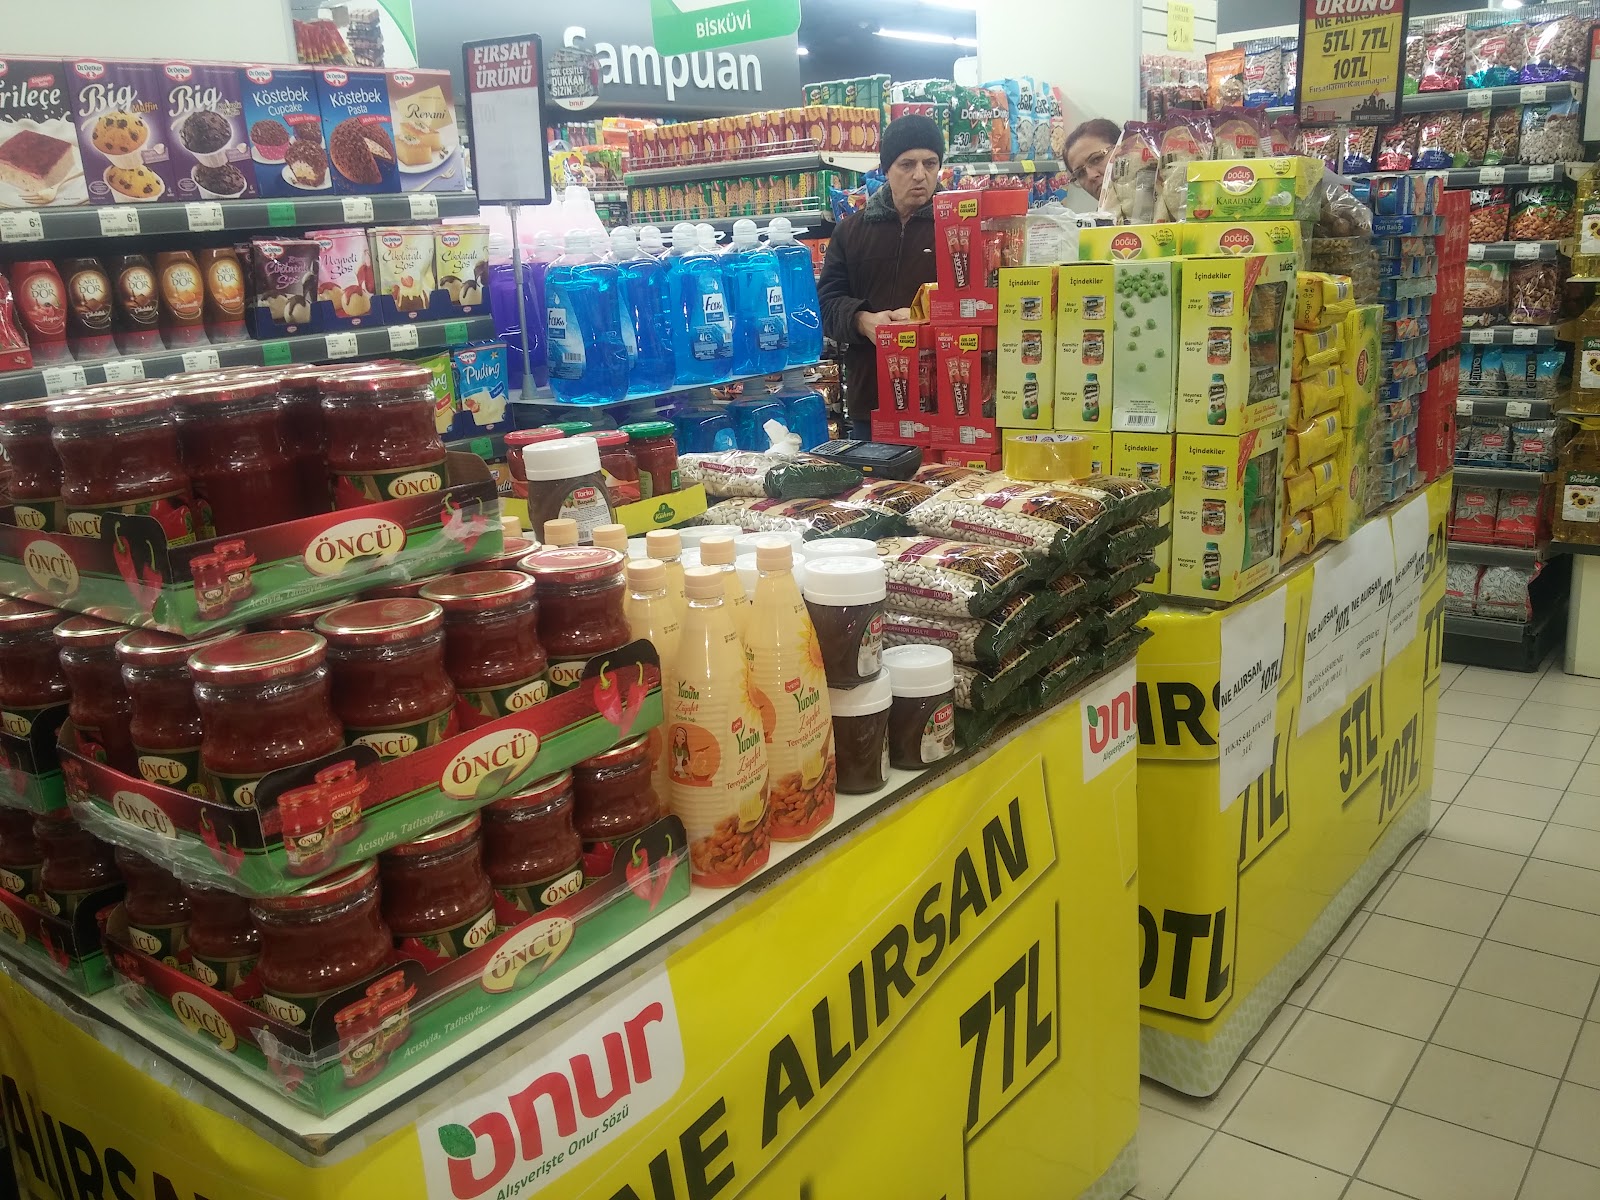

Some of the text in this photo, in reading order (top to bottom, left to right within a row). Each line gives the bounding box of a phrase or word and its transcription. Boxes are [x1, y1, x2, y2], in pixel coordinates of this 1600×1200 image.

[696, 9, 752, 39] BİSKÜVİ
[1323, 27, 1388, 53] 5TL 7TL
[473, 40, 531, 65] FIRSAT
[475, 60, 532, 89] ÜRÜNÜ
[1333, 56, 1368, 80] 10TL
[552, 74, 585, 87] DÜKKAN
[552, 85, 572, 97] SİZİN
[79, 83, 138, 117] Big
[132, 102, 158, 114] Muffin
[168, 86, 222, 117] Big
[252, 86, 309, 107] Köstebek
[329, 88, 381, 108] Köstebek
[267, 103, 302, 116] Cupcake
[347, 105, 368, 115] Pasta
[405, 103, 445, 119] Revani
[1227, 169, 1251, 180] DOĞUŞ
[1216, 195, 1262, 206] KARADENİZ
[1076, 218, 1092, 229] 5 kg
[1115, 236, 1138, 247] DOĞUŞ
[1224, 234, 1249, 244] DOĞUŞ
[1008, 277, 1041, 287] İçindekiler
[1070, 276, 1103, 286] İçindekiler
[1194, 271, 1231, 281] İçindekiler
[463, 362, 500, 384] Puding
[1124, 444, 1158, 453] İçindekiler
[1189, 446, 1226, 456] İçindekiler
[395, 473, 438, 496] ÖNCÜ
[1570, 474, 1597, 484] Bereket
[576, 489, 595, 497] Torku
[69, 514, 101, 536] ÖNCÜ
[654, 509, 674, 520] Kühne
[315, 524, 393, 562] ÖNCÜ
[28, 548, 72, 580] ÖNCÜ
[1394, 574, 1401, 586] NE
[1351, 598, 1360, 612] NE
[1359, 576, 1382, 605] ALIRSAN
[1378, 578, 1393, 607] 10TL
[1307, 604, 1349, 644] NE ALIRSAN 10TL
[512, 682, 548, 709] ÖNCÜ
[1221, 659, 1279, 708] NE ALIRSAN 10TL
[793, 682, 820, 713] Yudum
[798, 704, 820, 732] Ziyafet
[736, 725, 761, 754] Yudum
[1339, 684, 1378, 793] 5TL
[140, 759, 180, 780] ÖNCÜ
[452, 732, 528, 784] ÖNCÜ
[737, 747, 761, 775] Ziyafet
[1379, 712, 1419, 825] 10TL
[119, 799, 168, 834] ÖNCÜ
[356, 831, 397, 854] Acısıyla,
[546, 870, 581, 903] ÖNCÜ
[491, 920, 564, 979] ÖNCÜ
[762, 796, 1029, 1149] ALIRSAN
[177, 999, 229, 1038] ÖNCÜ
[403, 1032, 441, 1059] Acısıyla,
[959, 939, 1052, 1133] 7TL
[440, 1002, 664, 1200] onur
[495, 1103, 629, 1200] Alışverişte Onur Sözü
